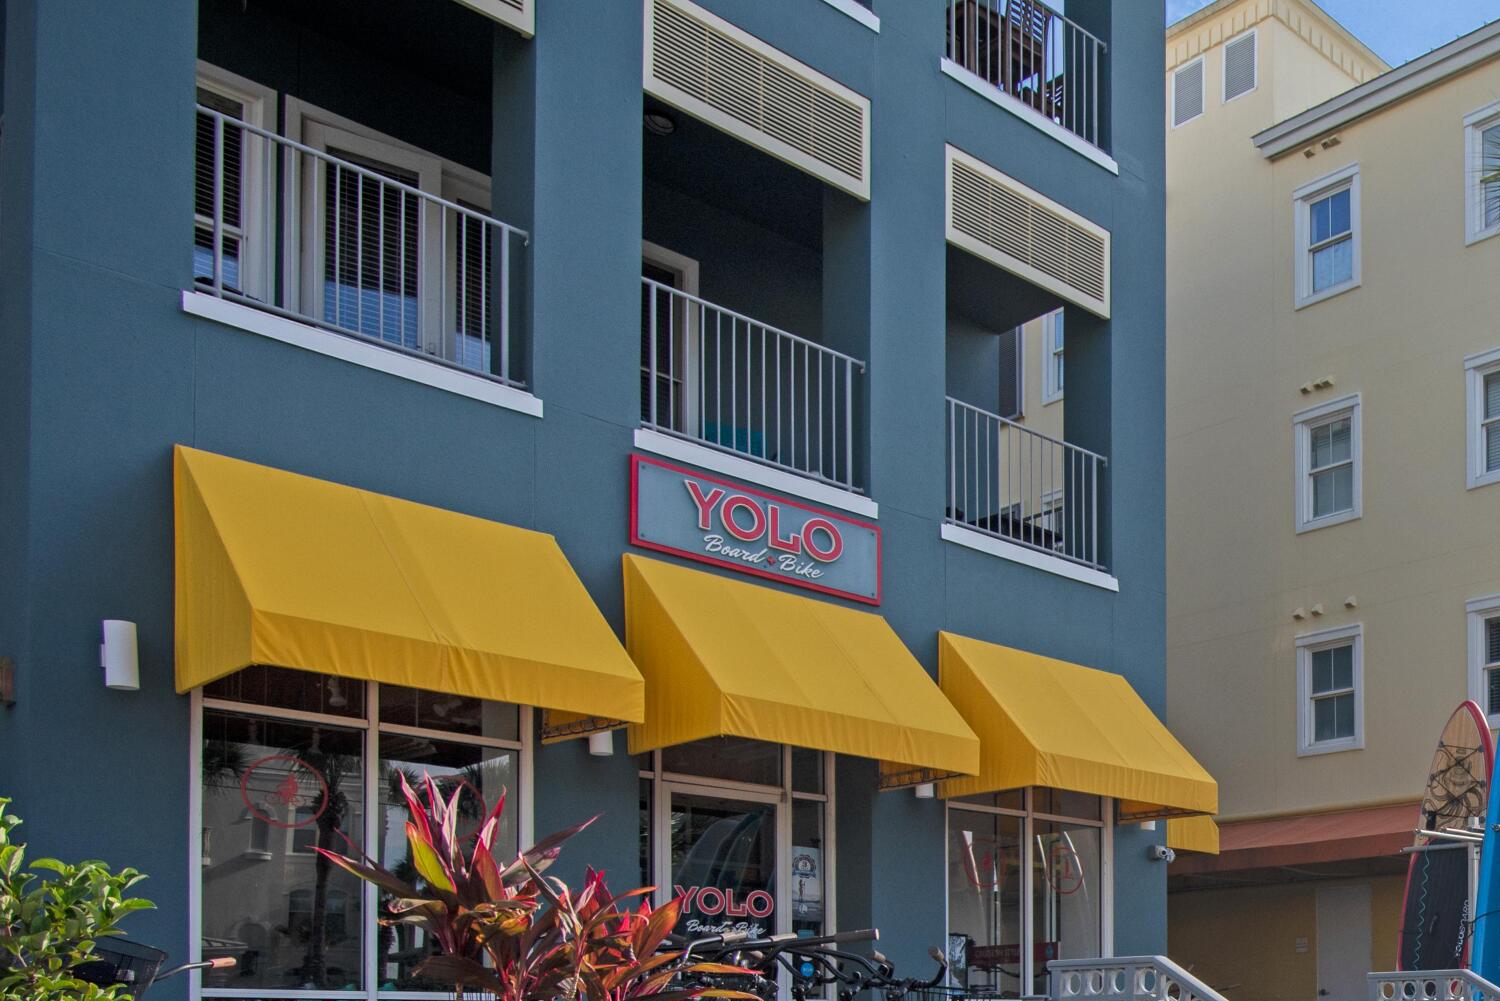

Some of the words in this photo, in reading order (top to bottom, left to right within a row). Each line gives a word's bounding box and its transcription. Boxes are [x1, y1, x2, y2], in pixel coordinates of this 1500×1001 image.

[684, 479, 844, 563] YOLO
[704, 534, 766, 564] Board
[778, 553, 824, 579] Bike
[673, 884, 774, 918] YOLO
[686, 919, 729, 932] Board
